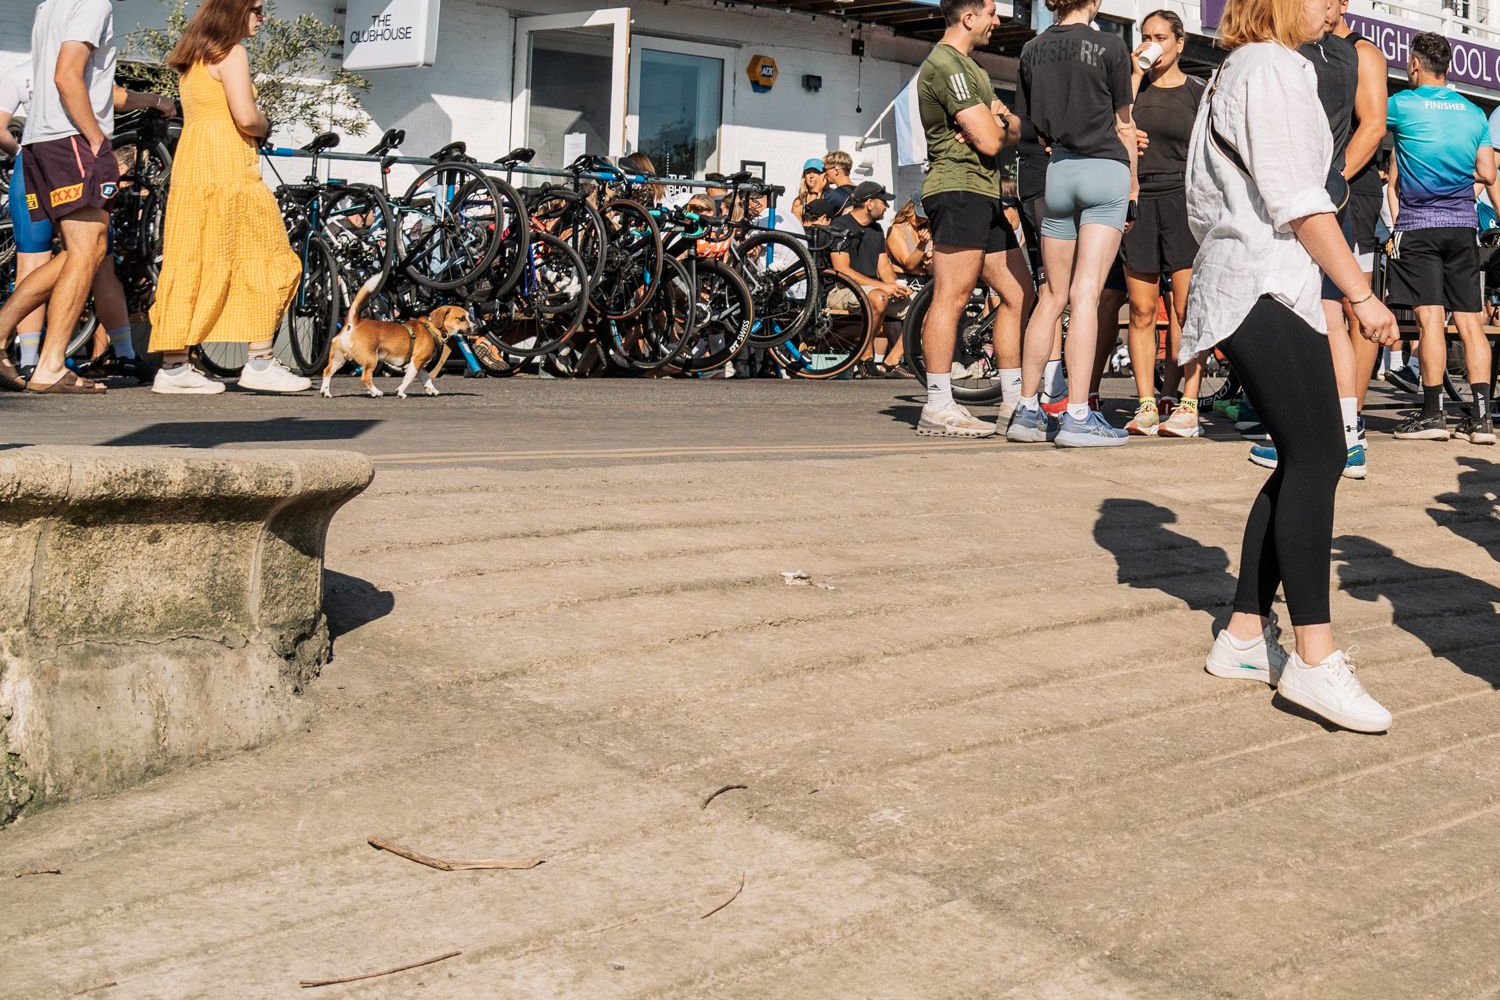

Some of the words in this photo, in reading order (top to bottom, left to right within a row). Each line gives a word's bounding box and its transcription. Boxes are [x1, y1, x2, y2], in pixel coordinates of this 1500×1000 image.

[371, 14, 392, 27] THE
[350, 26, 412, 44] CLUBHOUSE
[1361, 22, 1410, 63] HIGH
[1424, 101, 1466, 111] FINISHER
[729, 341, 740, 353] DT
[737, 320, 750, 341] SWISS
